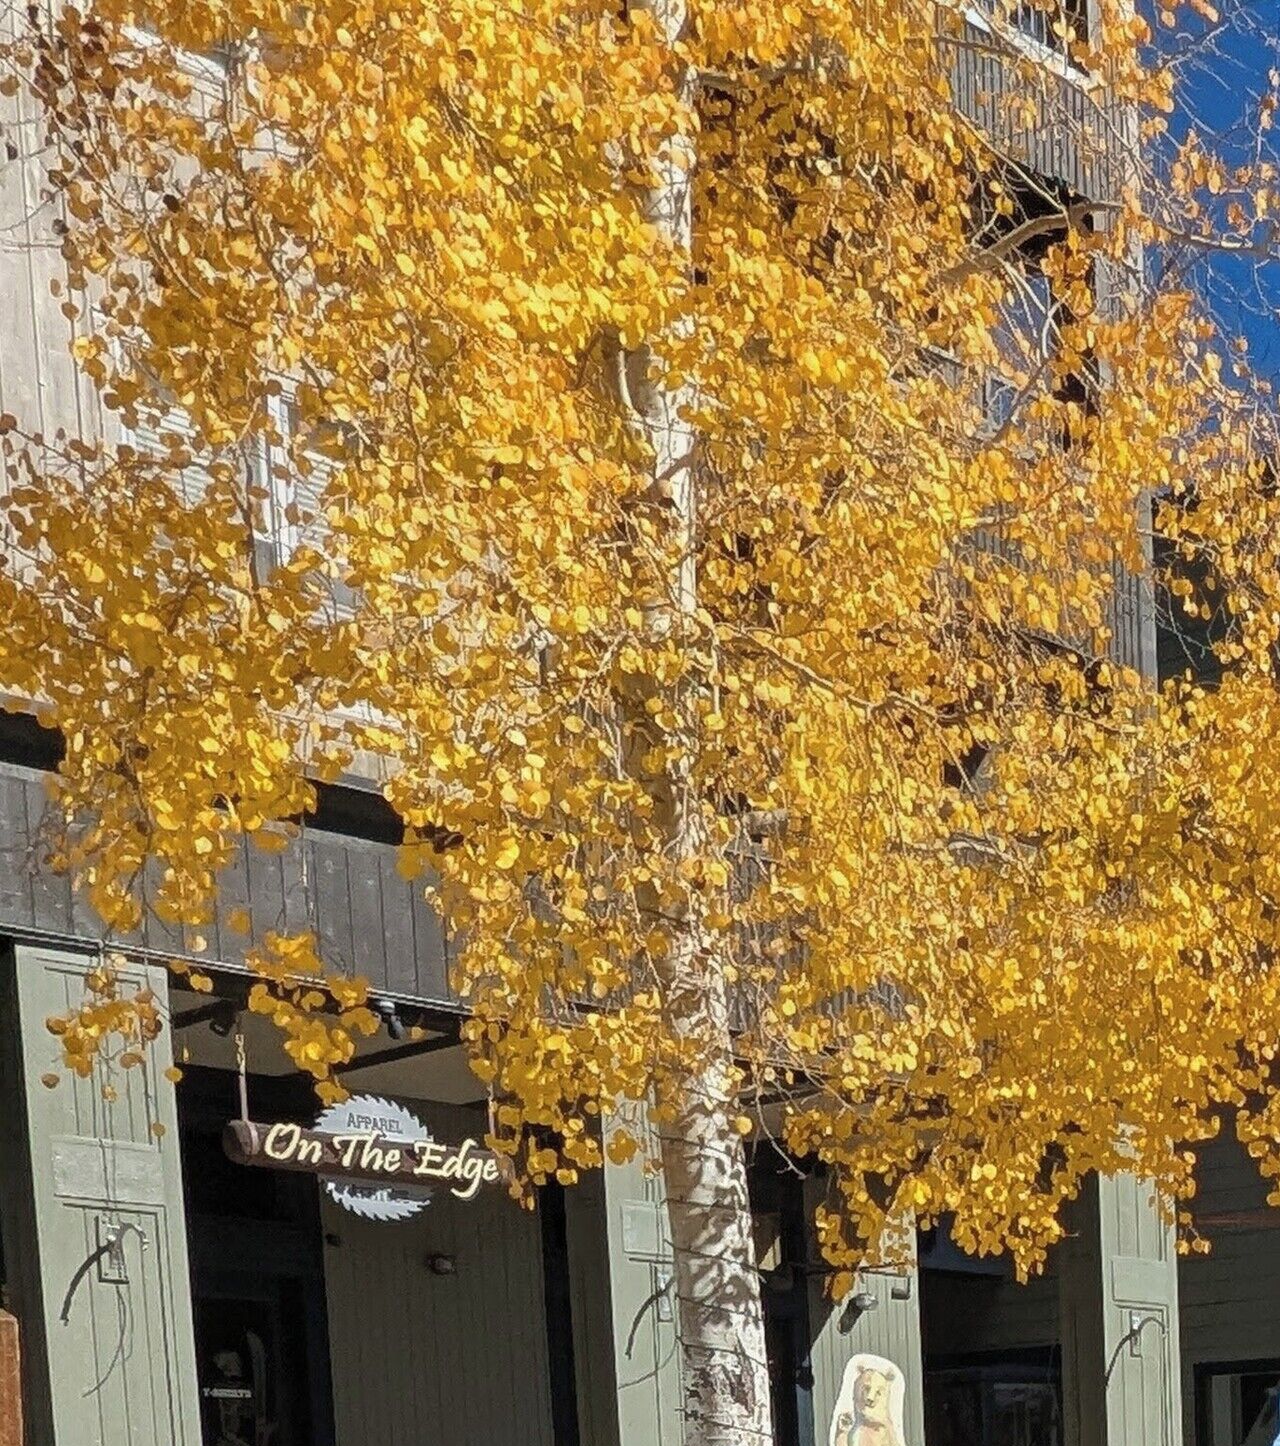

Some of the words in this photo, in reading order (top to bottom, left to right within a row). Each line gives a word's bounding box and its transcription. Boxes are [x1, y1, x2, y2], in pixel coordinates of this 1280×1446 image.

[346, 1111, 403, 1134] APPAREL
[264, 1122, 323, 1164] On
[332, 1129, 401, 1172] The
[413, 1139, 499, 1198] Edge
